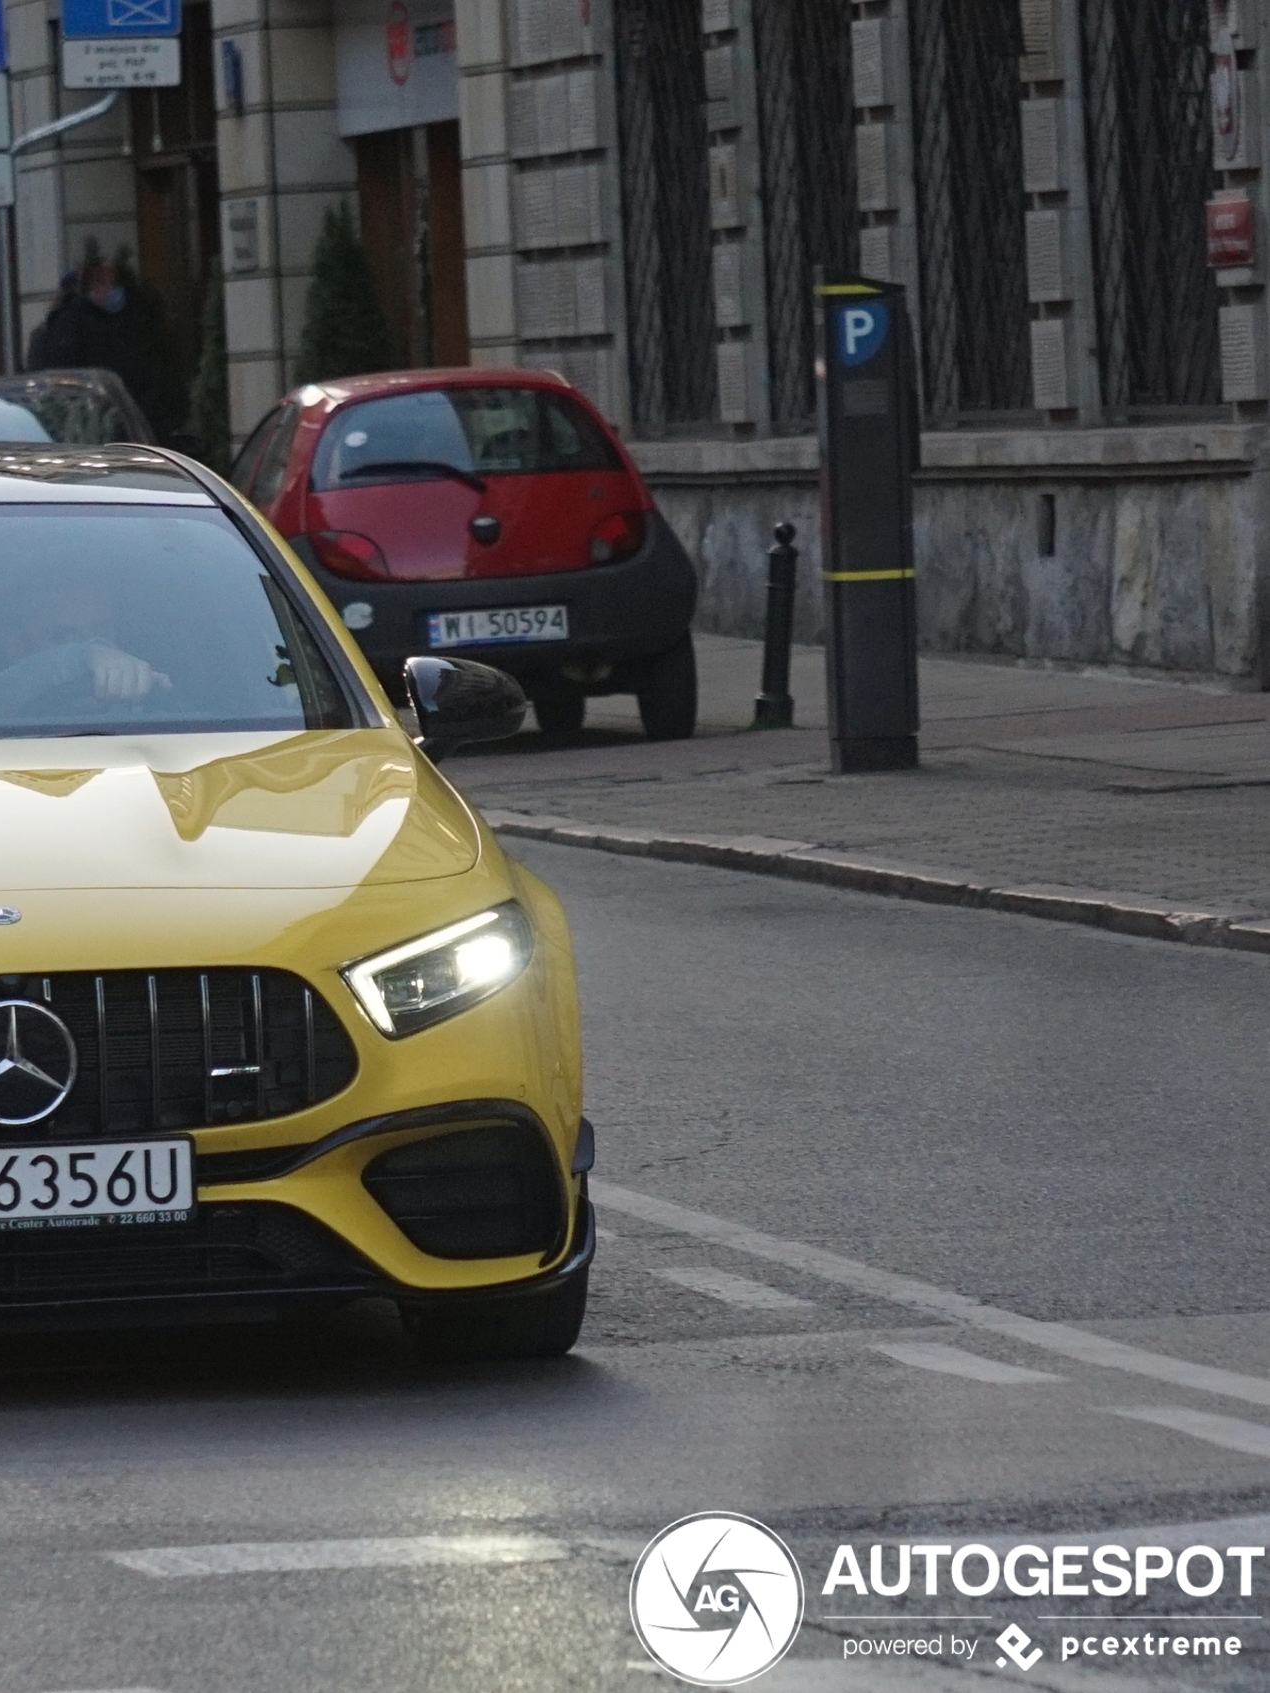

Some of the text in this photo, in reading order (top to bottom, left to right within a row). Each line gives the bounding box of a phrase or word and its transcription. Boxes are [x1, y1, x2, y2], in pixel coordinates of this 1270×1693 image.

[844, 309, 874, 355] P
[444, 609, 566, 640] WI 50594
[9, 1218, 44, 1229] Center
[46, 1215, 101, 1228] Autotrade
[120, 1214, 134, 1225] 22
[158, 1211, 172, 1223] 33
[173, 1210, 188, 1222] 00
